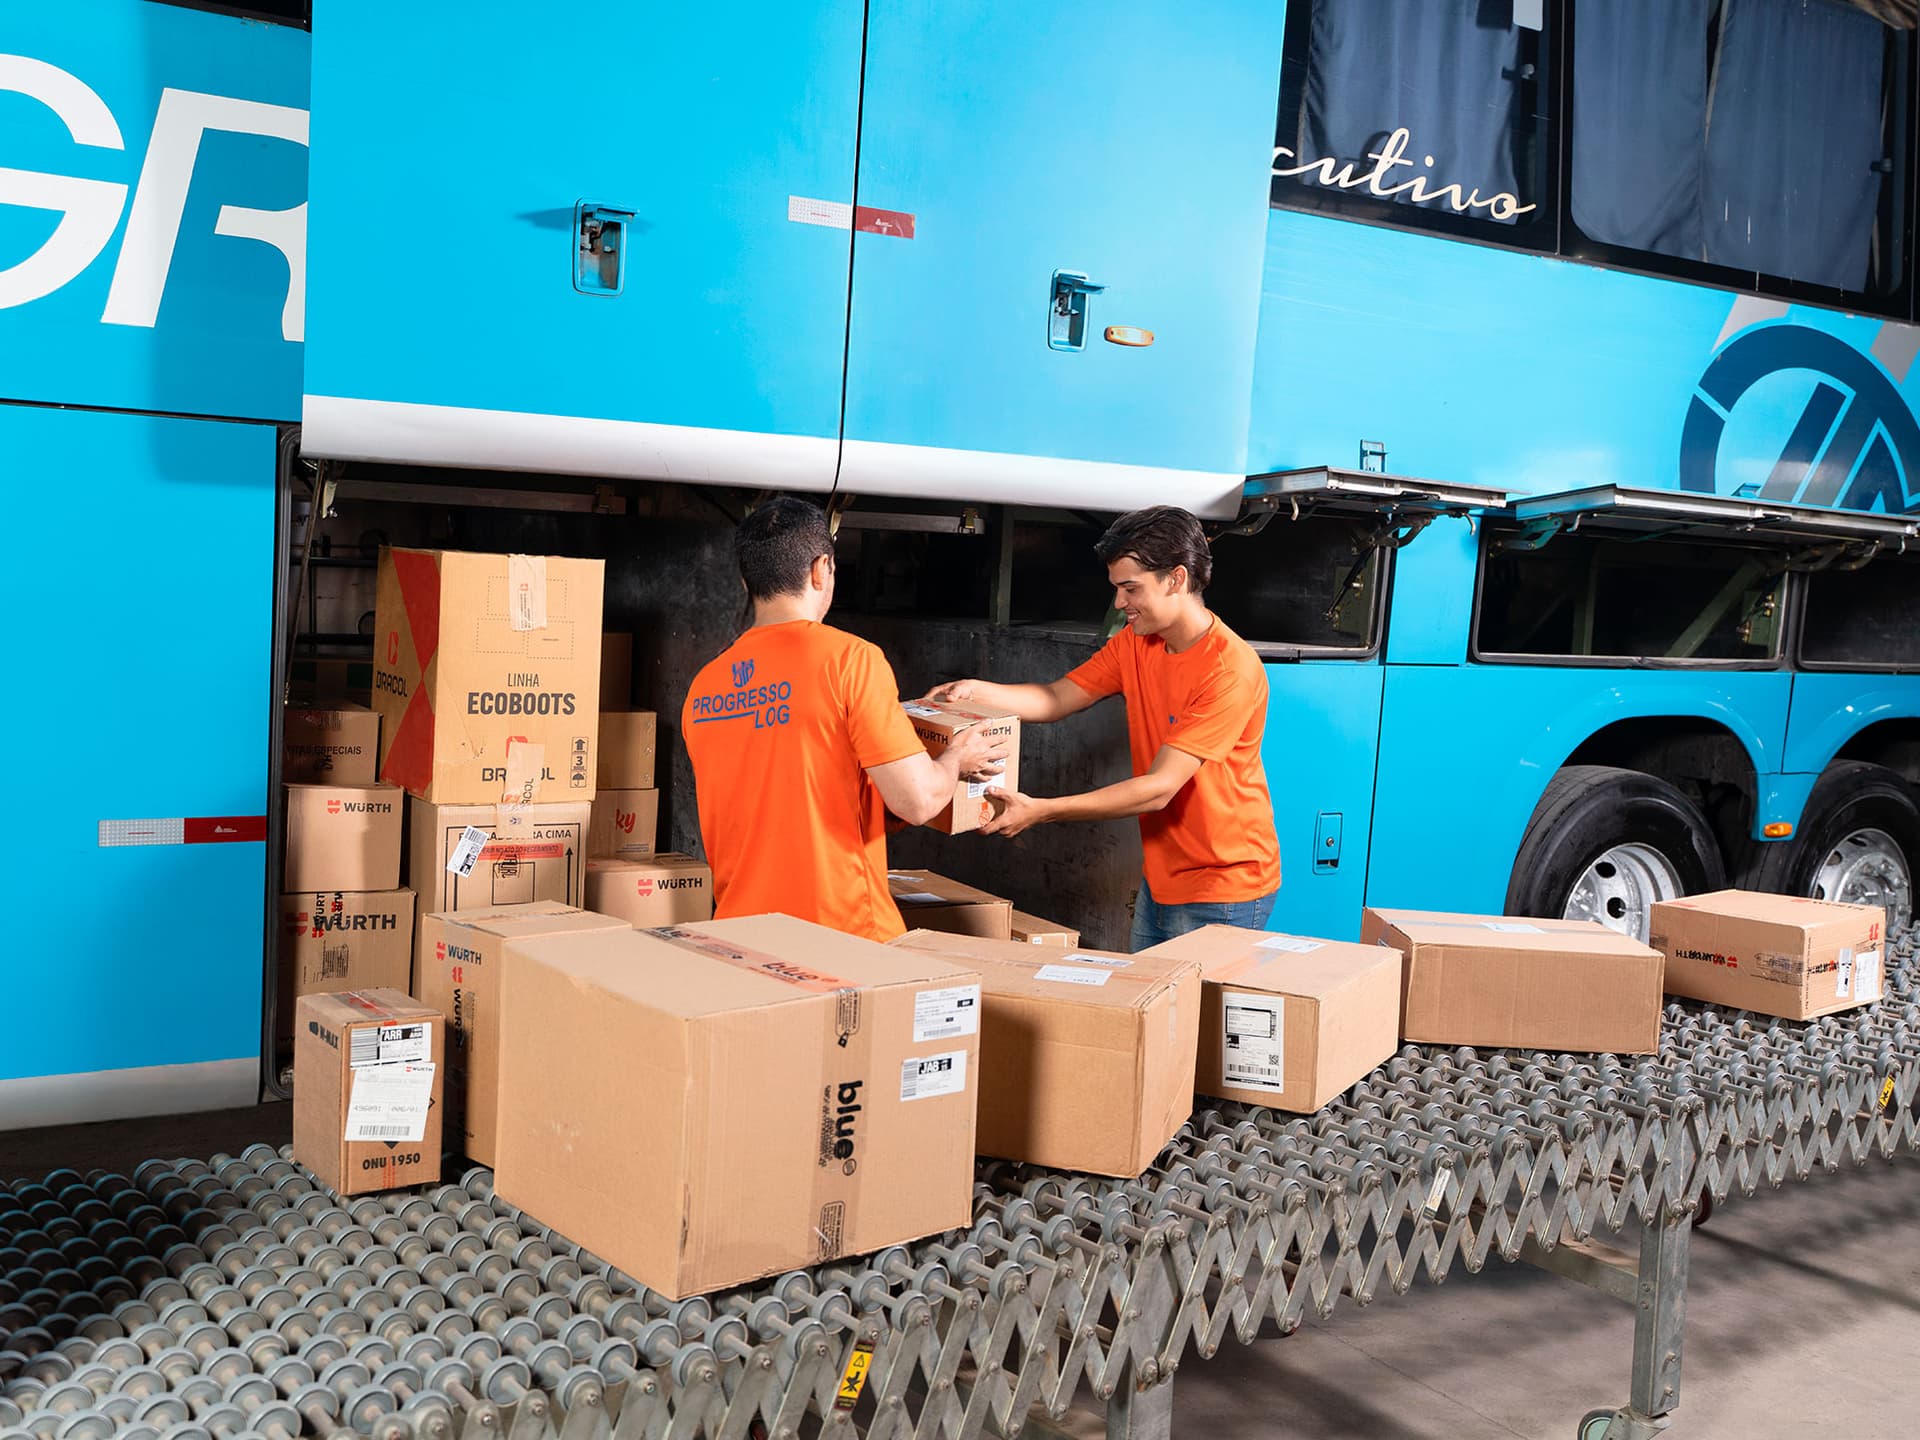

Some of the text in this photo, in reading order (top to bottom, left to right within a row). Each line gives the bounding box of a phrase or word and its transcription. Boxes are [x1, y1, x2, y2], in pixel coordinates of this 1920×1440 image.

[507, 672, 540, 688] LINHA
[467, 691, 576, 716] ECOBOOTS
[693, 681, 792, 716] PROGRESSO
[754, 704, 790, 729] LOG
[575, 755, 583, 766] 3
[545, 829, 572, 838] CIMA
[384, 1029, 402, 1041] ARR
[833, 1080, 863, 1162] blue
[362, 1152, 421, 1170] ONU 1950
